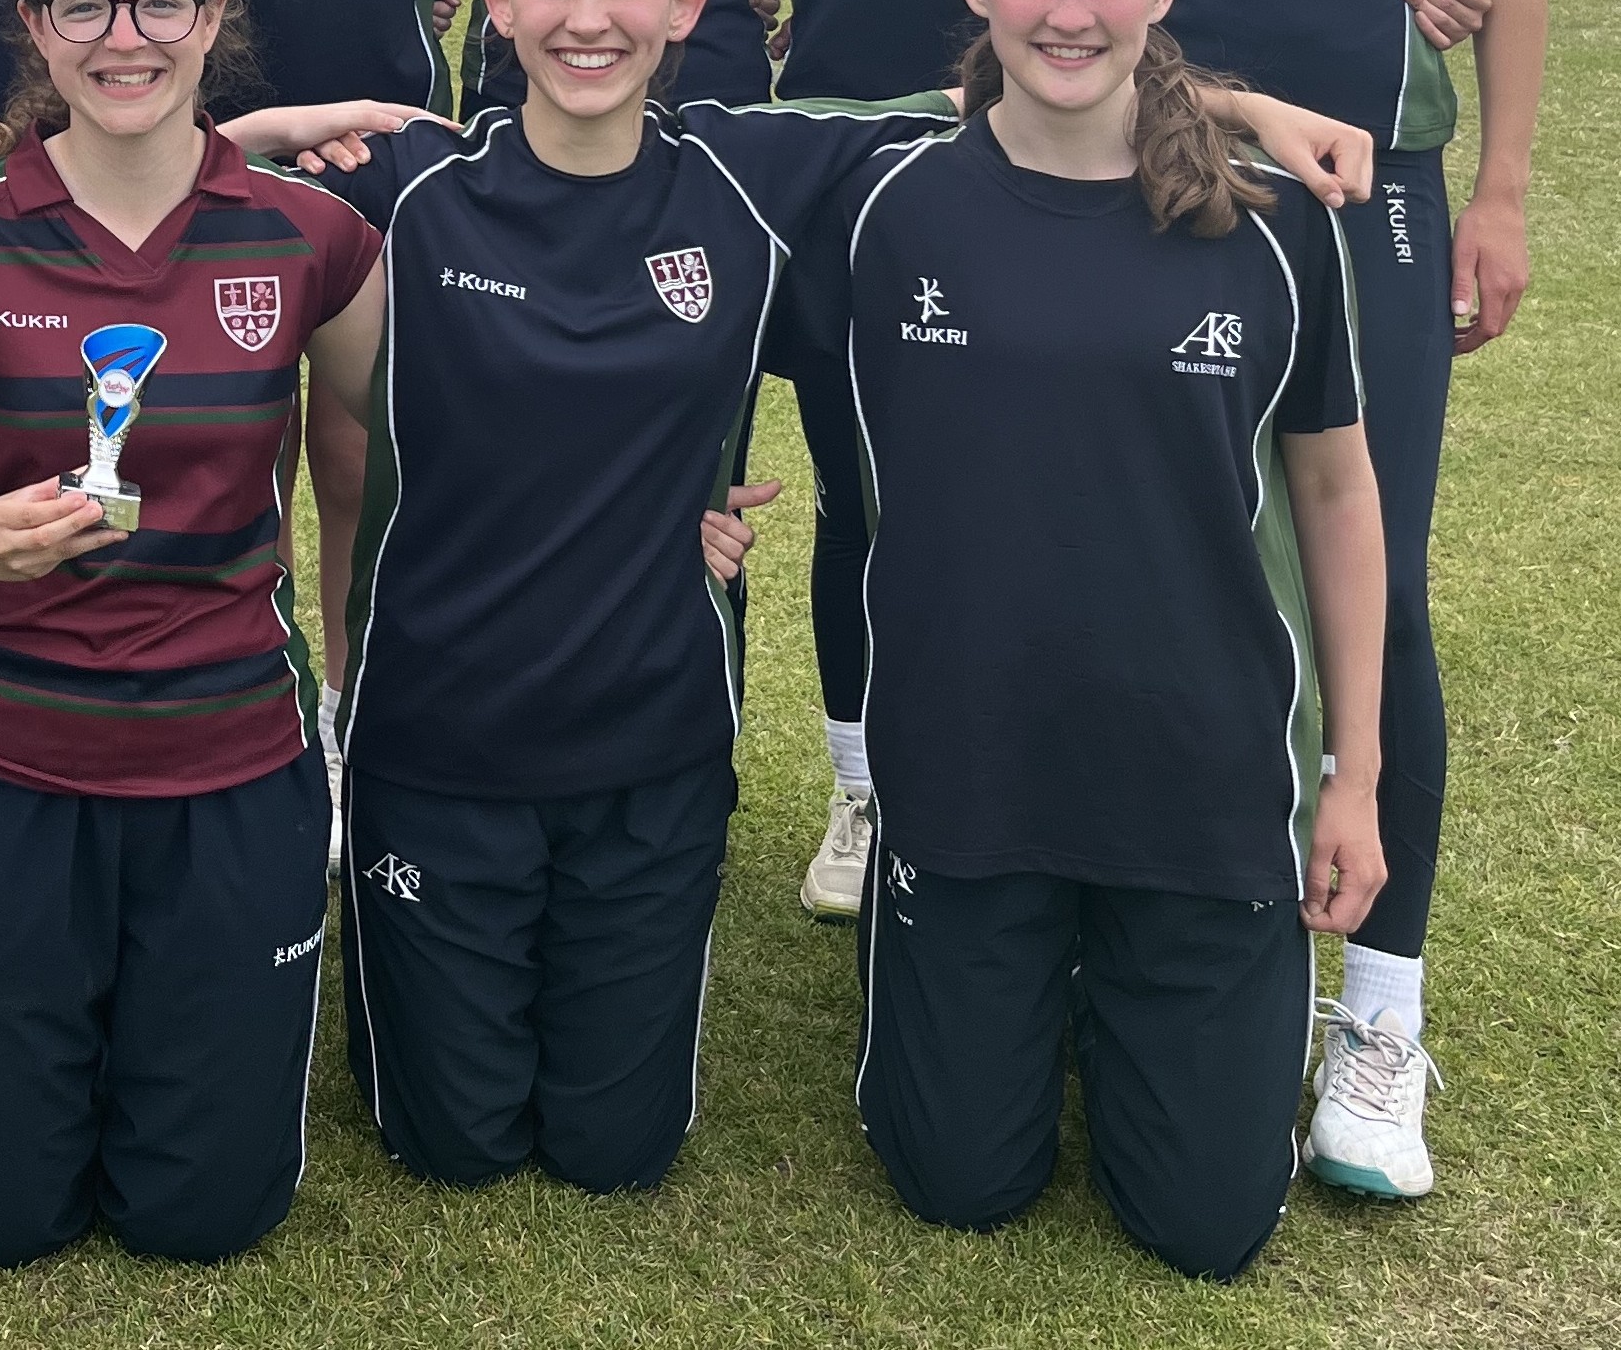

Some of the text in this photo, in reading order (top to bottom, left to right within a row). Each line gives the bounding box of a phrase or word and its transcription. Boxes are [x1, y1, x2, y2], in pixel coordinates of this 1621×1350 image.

[1386, 198, 1414, 264] KUKRI
[457, 271, 527, 300] KUKRI
[900, 322, 968, 346] KUKRI
